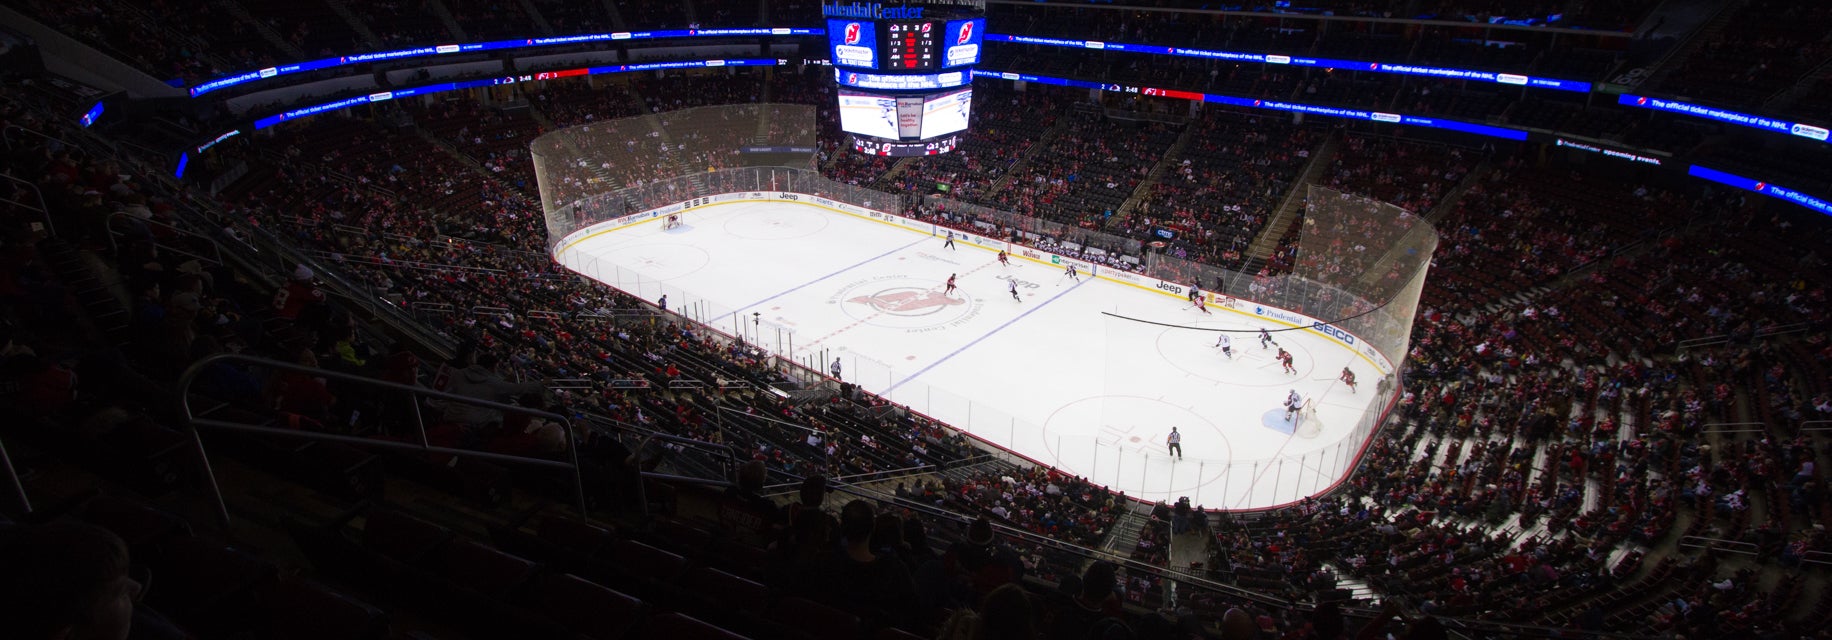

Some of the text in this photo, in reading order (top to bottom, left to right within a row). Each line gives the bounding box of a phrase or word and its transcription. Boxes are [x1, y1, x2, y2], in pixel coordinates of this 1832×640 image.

[872, 3, 924, 19] Center
[1666, 103, 1690, 111] official
[1708, 111, 1748, 122] marketplace
[1771, 121, 1789, 130] NHL.
[1603, 150, 1636, 161] upcoming
[780, 192, 798, 200] Jeep
[1771, 187, 1785, 195] The
[1786, 192, 1808, 202] official
[1808, 199, 1826, 209] ticket
[1022, 249, 1040, 260] Wawa
[1156, 280, 1182, 294] Jeep
[1266, 309, 1302, 324] Prudential
[1314, 321, 1354, 345] GEICO
